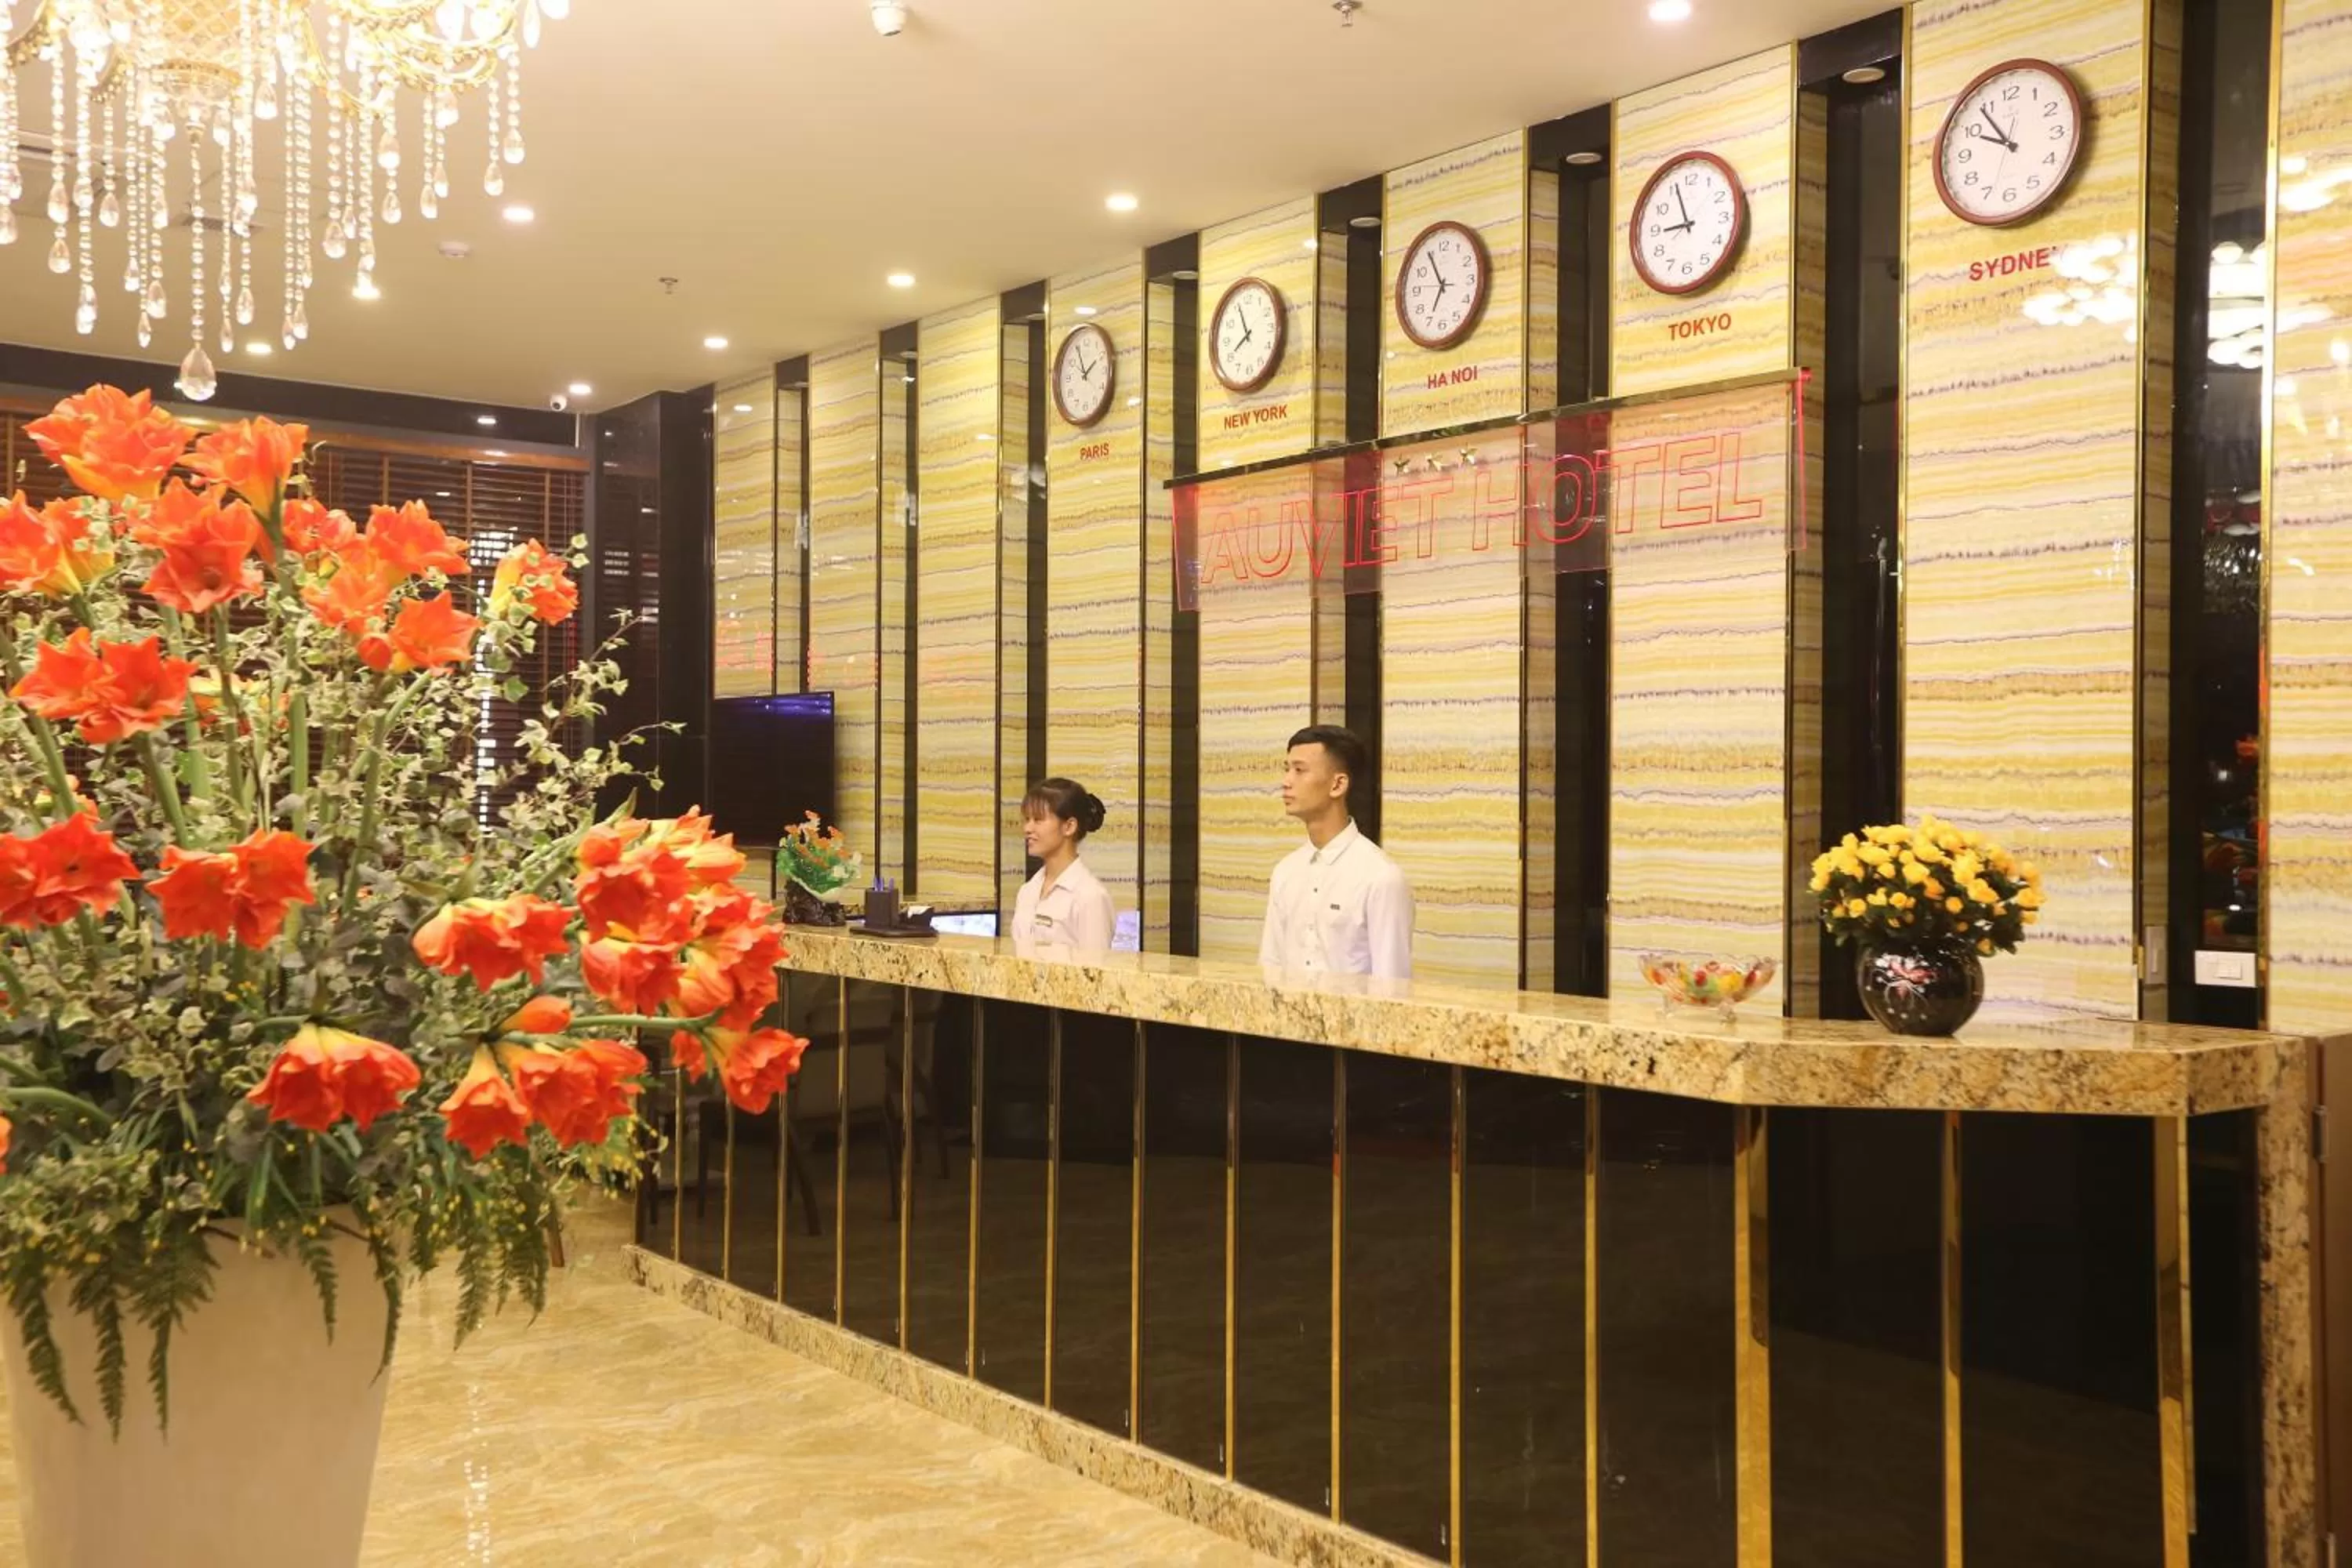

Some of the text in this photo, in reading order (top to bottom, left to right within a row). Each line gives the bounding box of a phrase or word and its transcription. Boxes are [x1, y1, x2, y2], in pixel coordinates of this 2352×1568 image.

[2002, 86, 2020, 100] 12
[2032, 87, 2038, 100] 1
[2044, 102, 2058, 118] 2
[1965, 123, 1982, 138] 10
[2049, 125, 2064, 140] 3
[1958, 148, 1972, 163] 9
[2042, 152, 2056, 165] 4
[1685, 174, 1698, 186] 12
[1707, 176, 1711, 187] 1
[1964, 172, 1979, 185] 8
[2026, 175, 2040, 189] 5
[1714, 191, 1726, 204] 2
[1981, 186, 1994, 200] 7
[2002, 187, 2016, 202] 6
[1656, 202, 1668, 215] 10
[1718, 212, 1730, 224] 3
[1650, 224, 1661, 237] 9
[1712, 234, 1722, 246] 4
[1653, 245, 1664, 257] 8
[1666, 259, 1676, 272] 7
[1700, 253, 1711, 266] 5
[1969, 246, 2057, 281] SYDNE
[1682, 262, 1693, 274] 6
[1668, 313, 1731, 342] TOKYO
[1224, 404, 1288, 430] NEW YORK
[1080, 443, 1109, 459] PARIS
[1472, 432, 1763, 550] HOTEL
